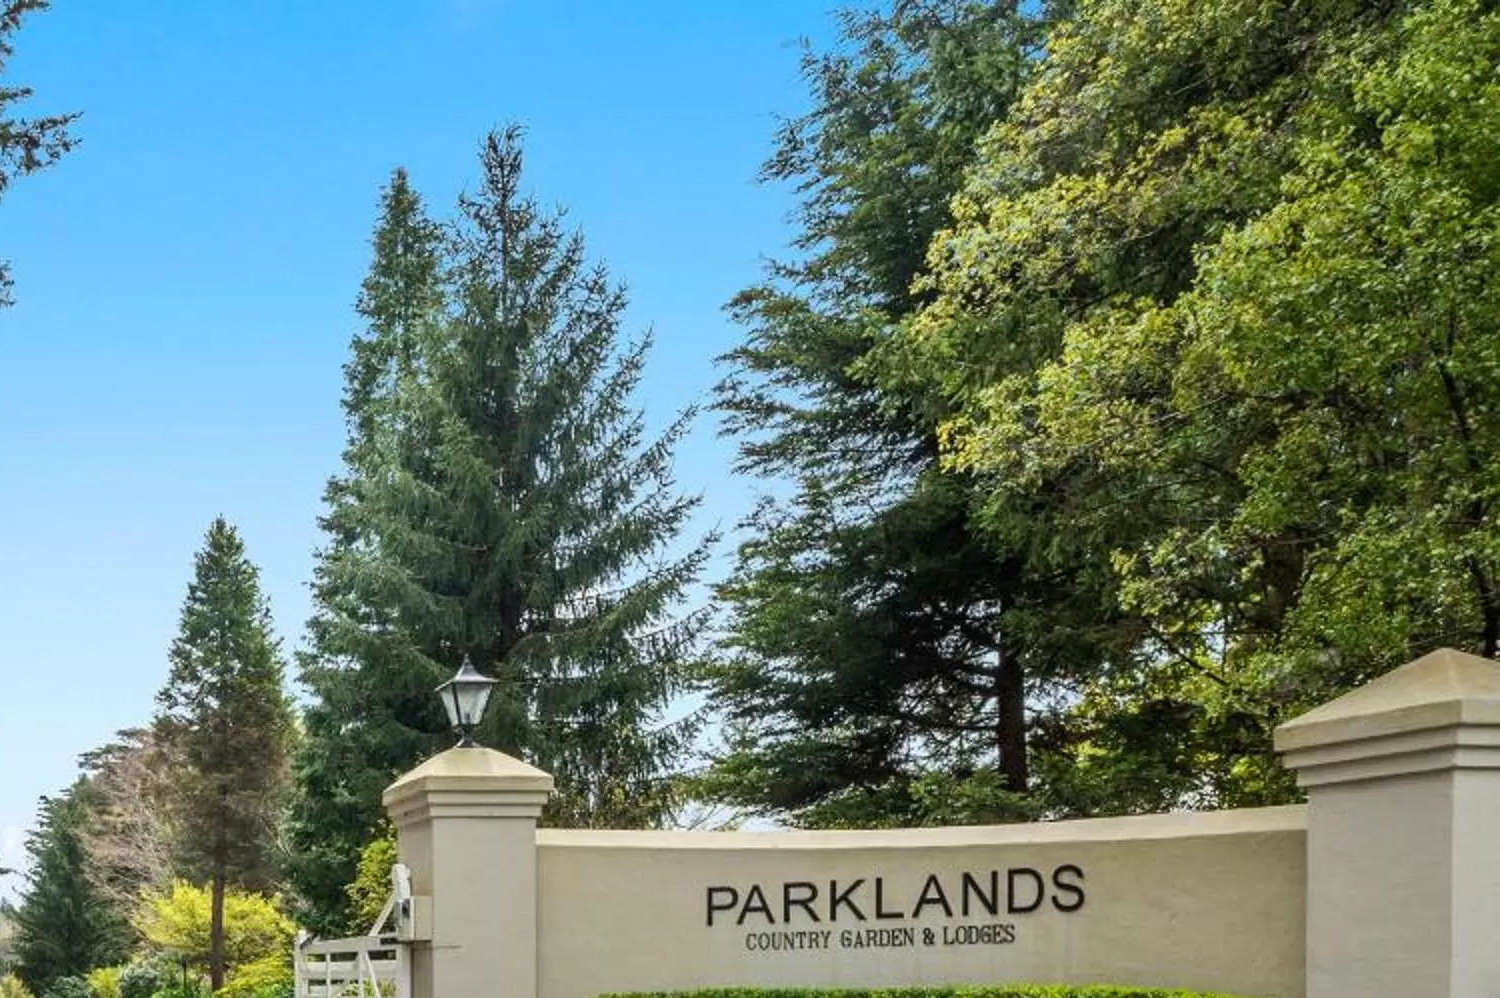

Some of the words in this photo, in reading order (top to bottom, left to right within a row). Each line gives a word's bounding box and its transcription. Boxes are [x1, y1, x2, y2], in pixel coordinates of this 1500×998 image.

[707, 864, 1085, 926] PARKLANDS
[746, 931, 832, 951] COUNTRY
[841, 928, 915, 948] GARDEN
[923, 927, 935, 945] &
[943, 925, 1016, 945] LODGES
